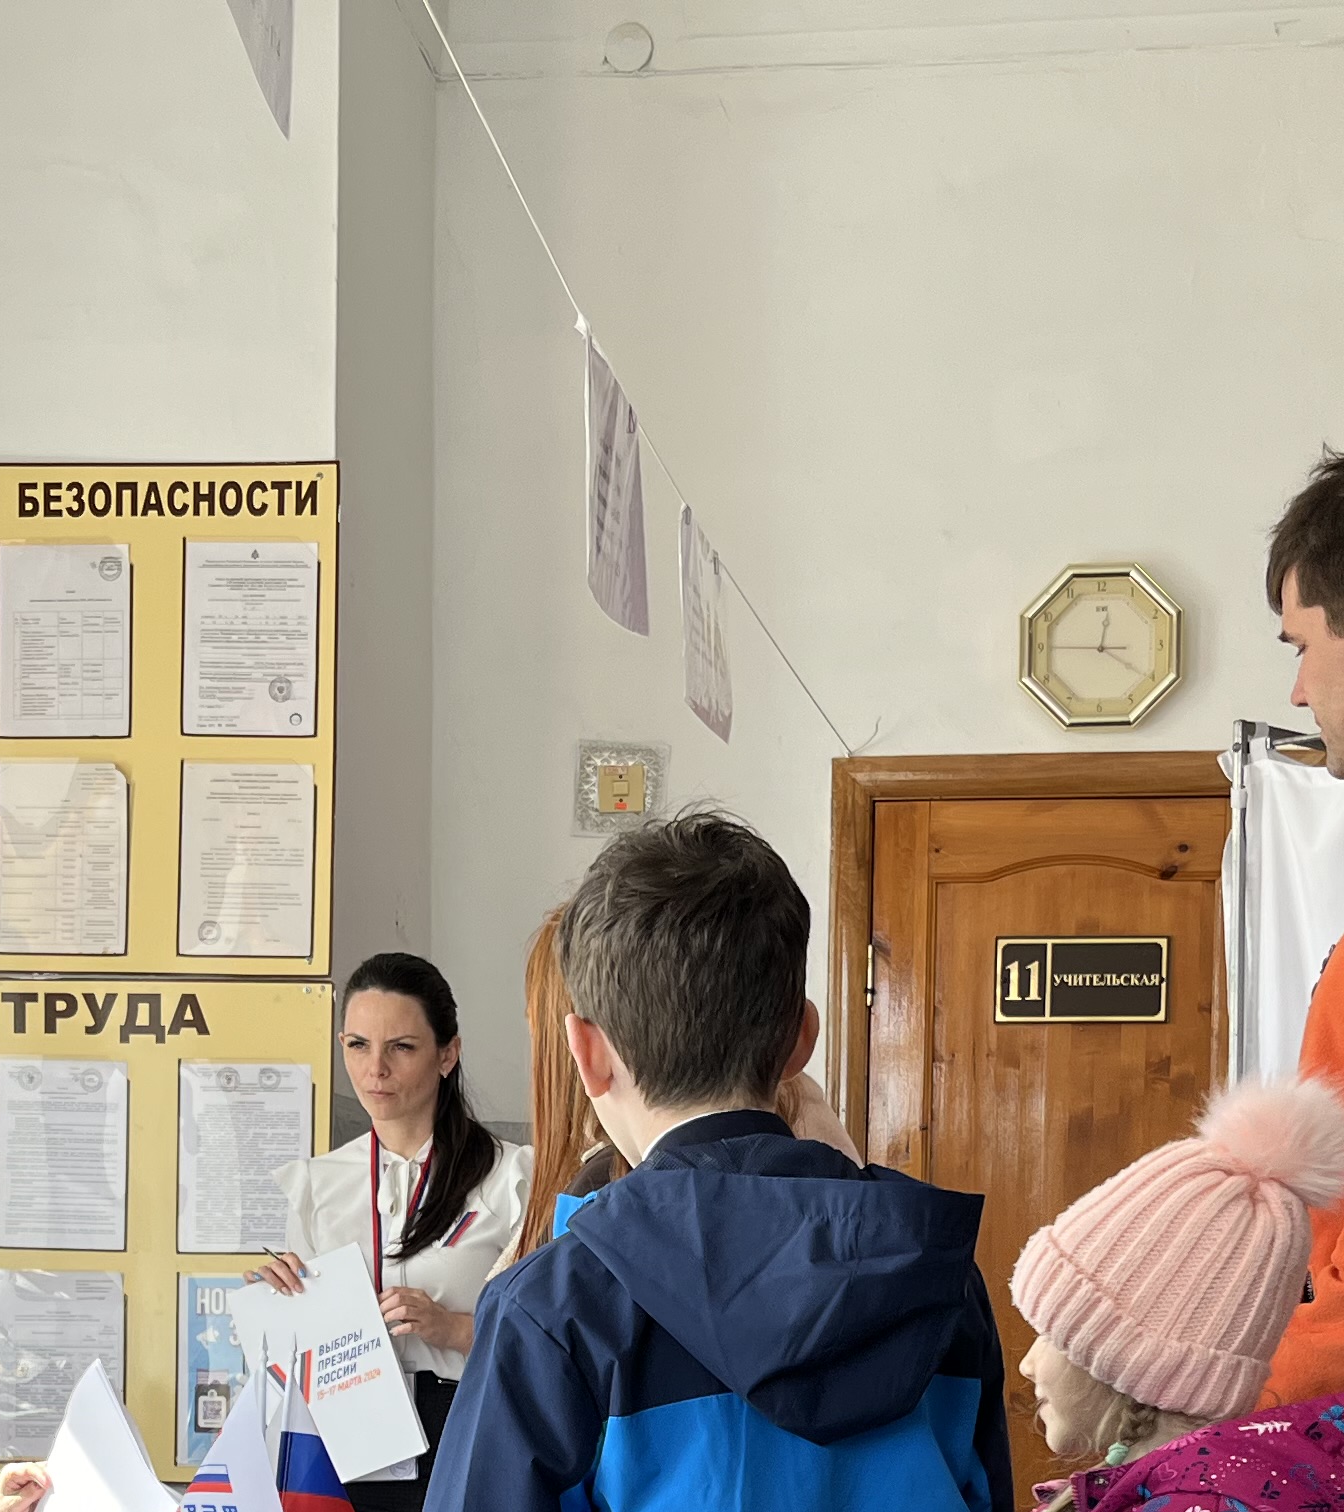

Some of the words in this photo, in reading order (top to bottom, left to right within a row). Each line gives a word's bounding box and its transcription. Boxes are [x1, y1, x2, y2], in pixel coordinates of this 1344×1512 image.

[18, 480, 319, 518] БЕЗОПАСНОСТИ
[1097, 581, 1107, 592] 12
[1043, 612, 1053, 622] 10
[1004, 960, 1042, 1001] 11
[1053, 973, 1161, 988] УЧИТЕЛЬСКАЯ
[1, 992, 211, 1044] ТРУДА
[318, 1329, 363, 1356] ВЫБОРЫ
[318, 1337, 381, 1372] ПРЕЗИДЕНТА
[317, 1362, 357, 1388] РОССИИ
